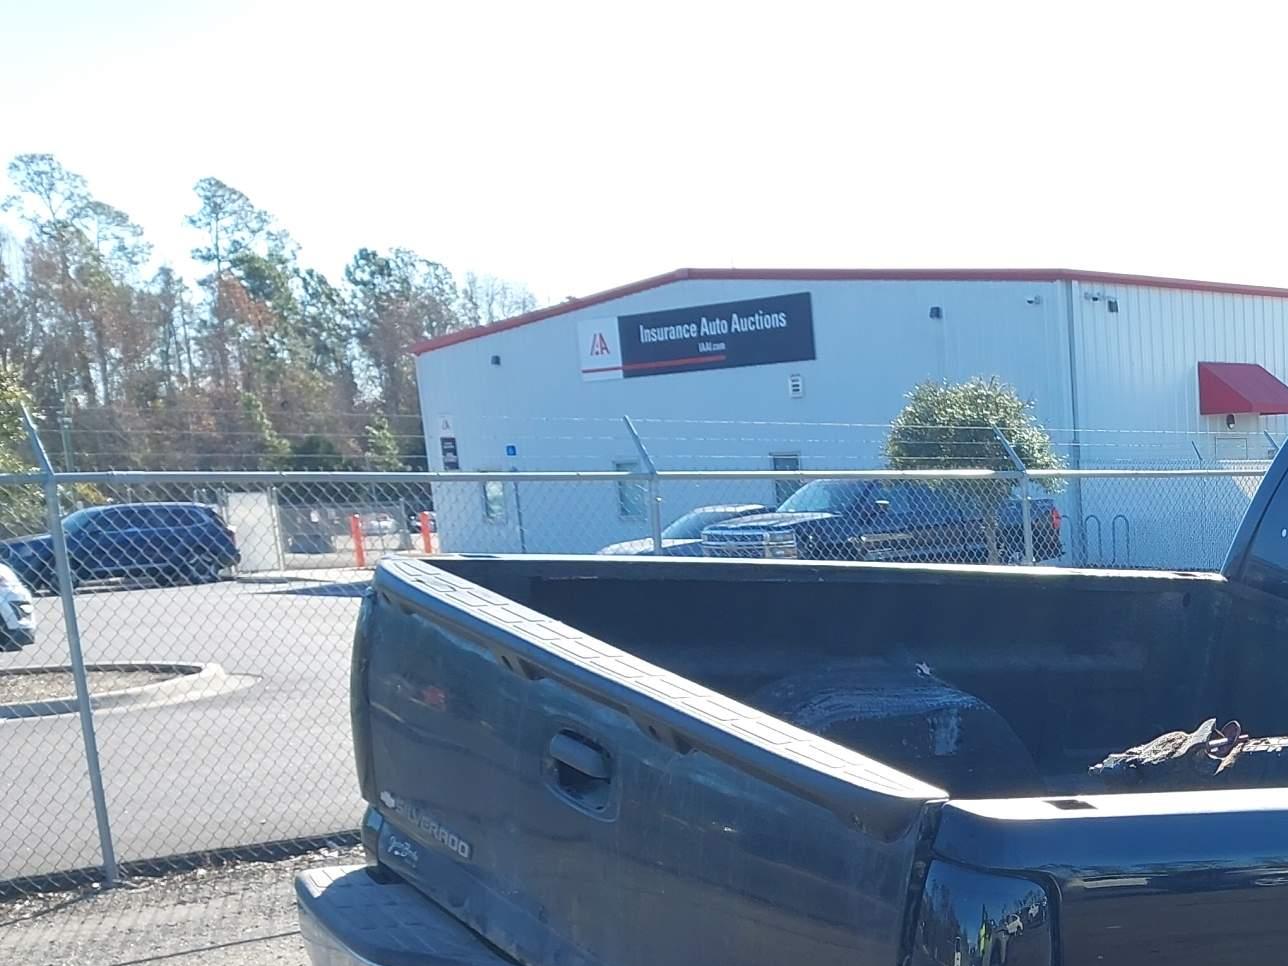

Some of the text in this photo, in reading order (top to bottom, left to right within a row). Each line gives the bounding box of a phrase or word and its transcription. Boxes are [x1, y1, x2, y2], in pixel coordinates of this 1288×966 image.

[639, 310, 787, 343] Insurance Auto Auctions
